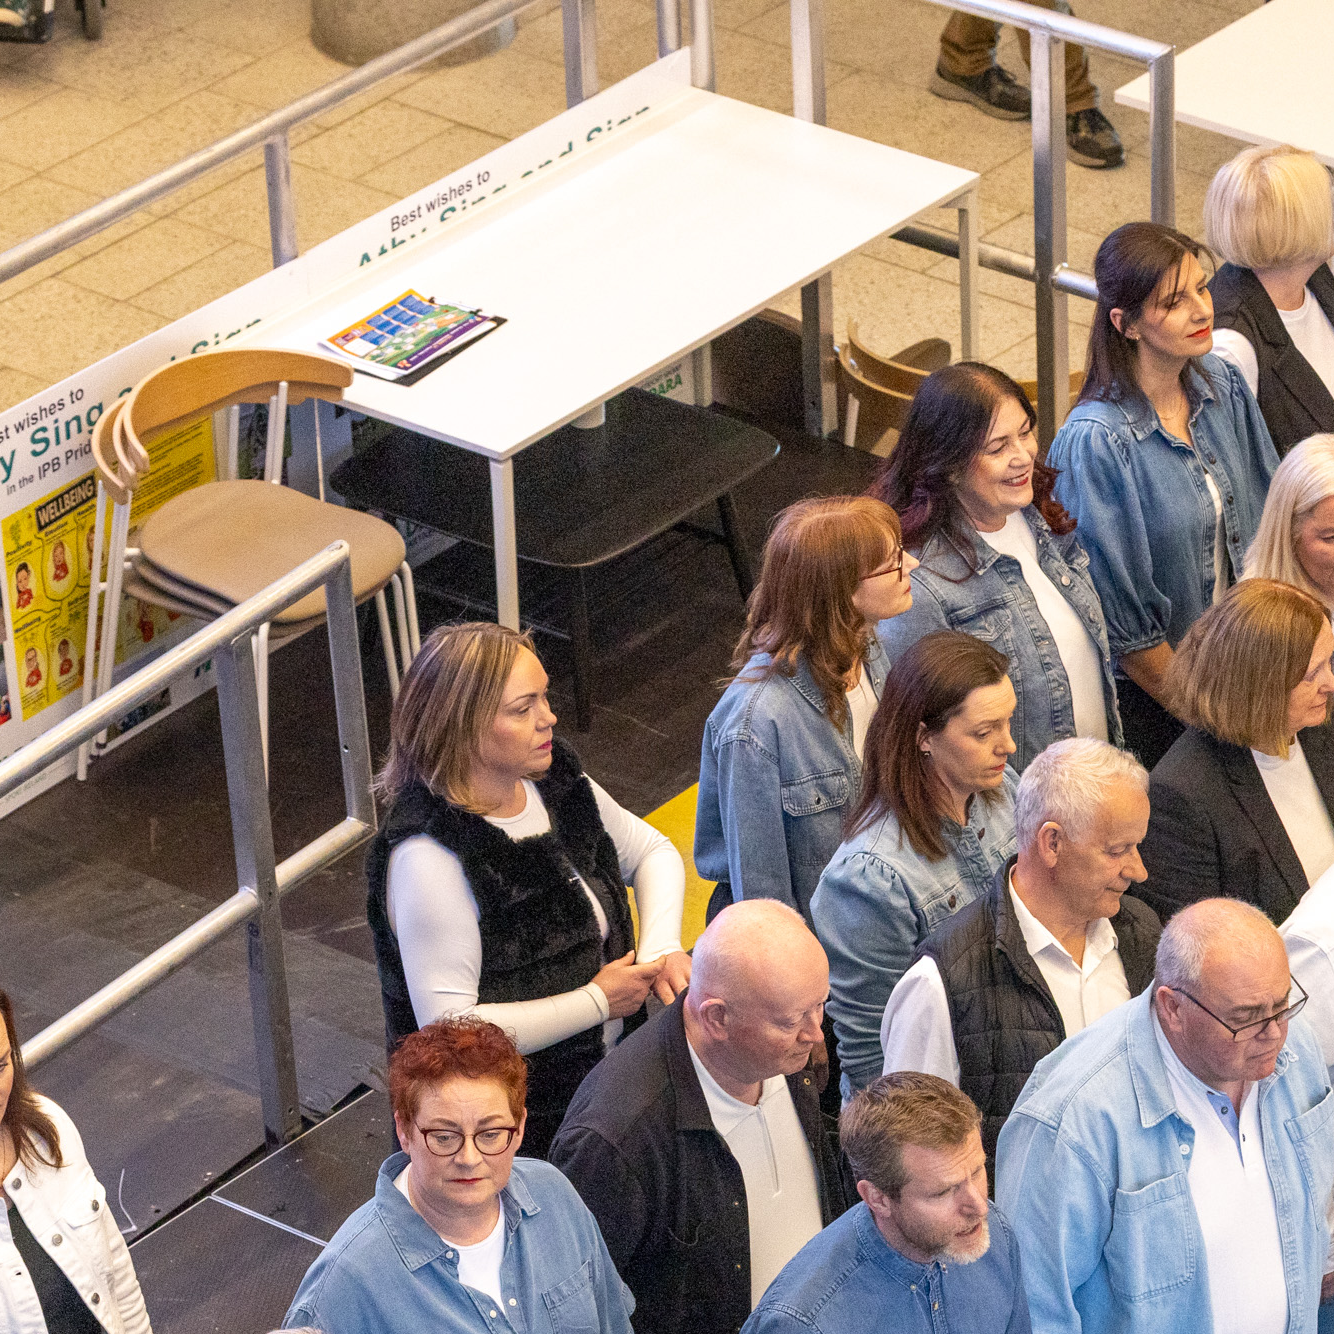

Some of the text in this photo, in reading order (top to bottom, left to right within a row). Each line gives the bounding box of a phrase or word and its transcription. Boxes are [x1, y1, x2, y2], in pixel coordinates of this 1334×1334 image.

[390, 170, 491, 233] Best wishes to
[14, 398, 65, 435] wishes
[69, 388, 84, 404] to
[30, 401, 103, 457] Sing
[6, 438, 92, 496] in the IPB Prid
[37, 477, 95, 528] WELLBEING
